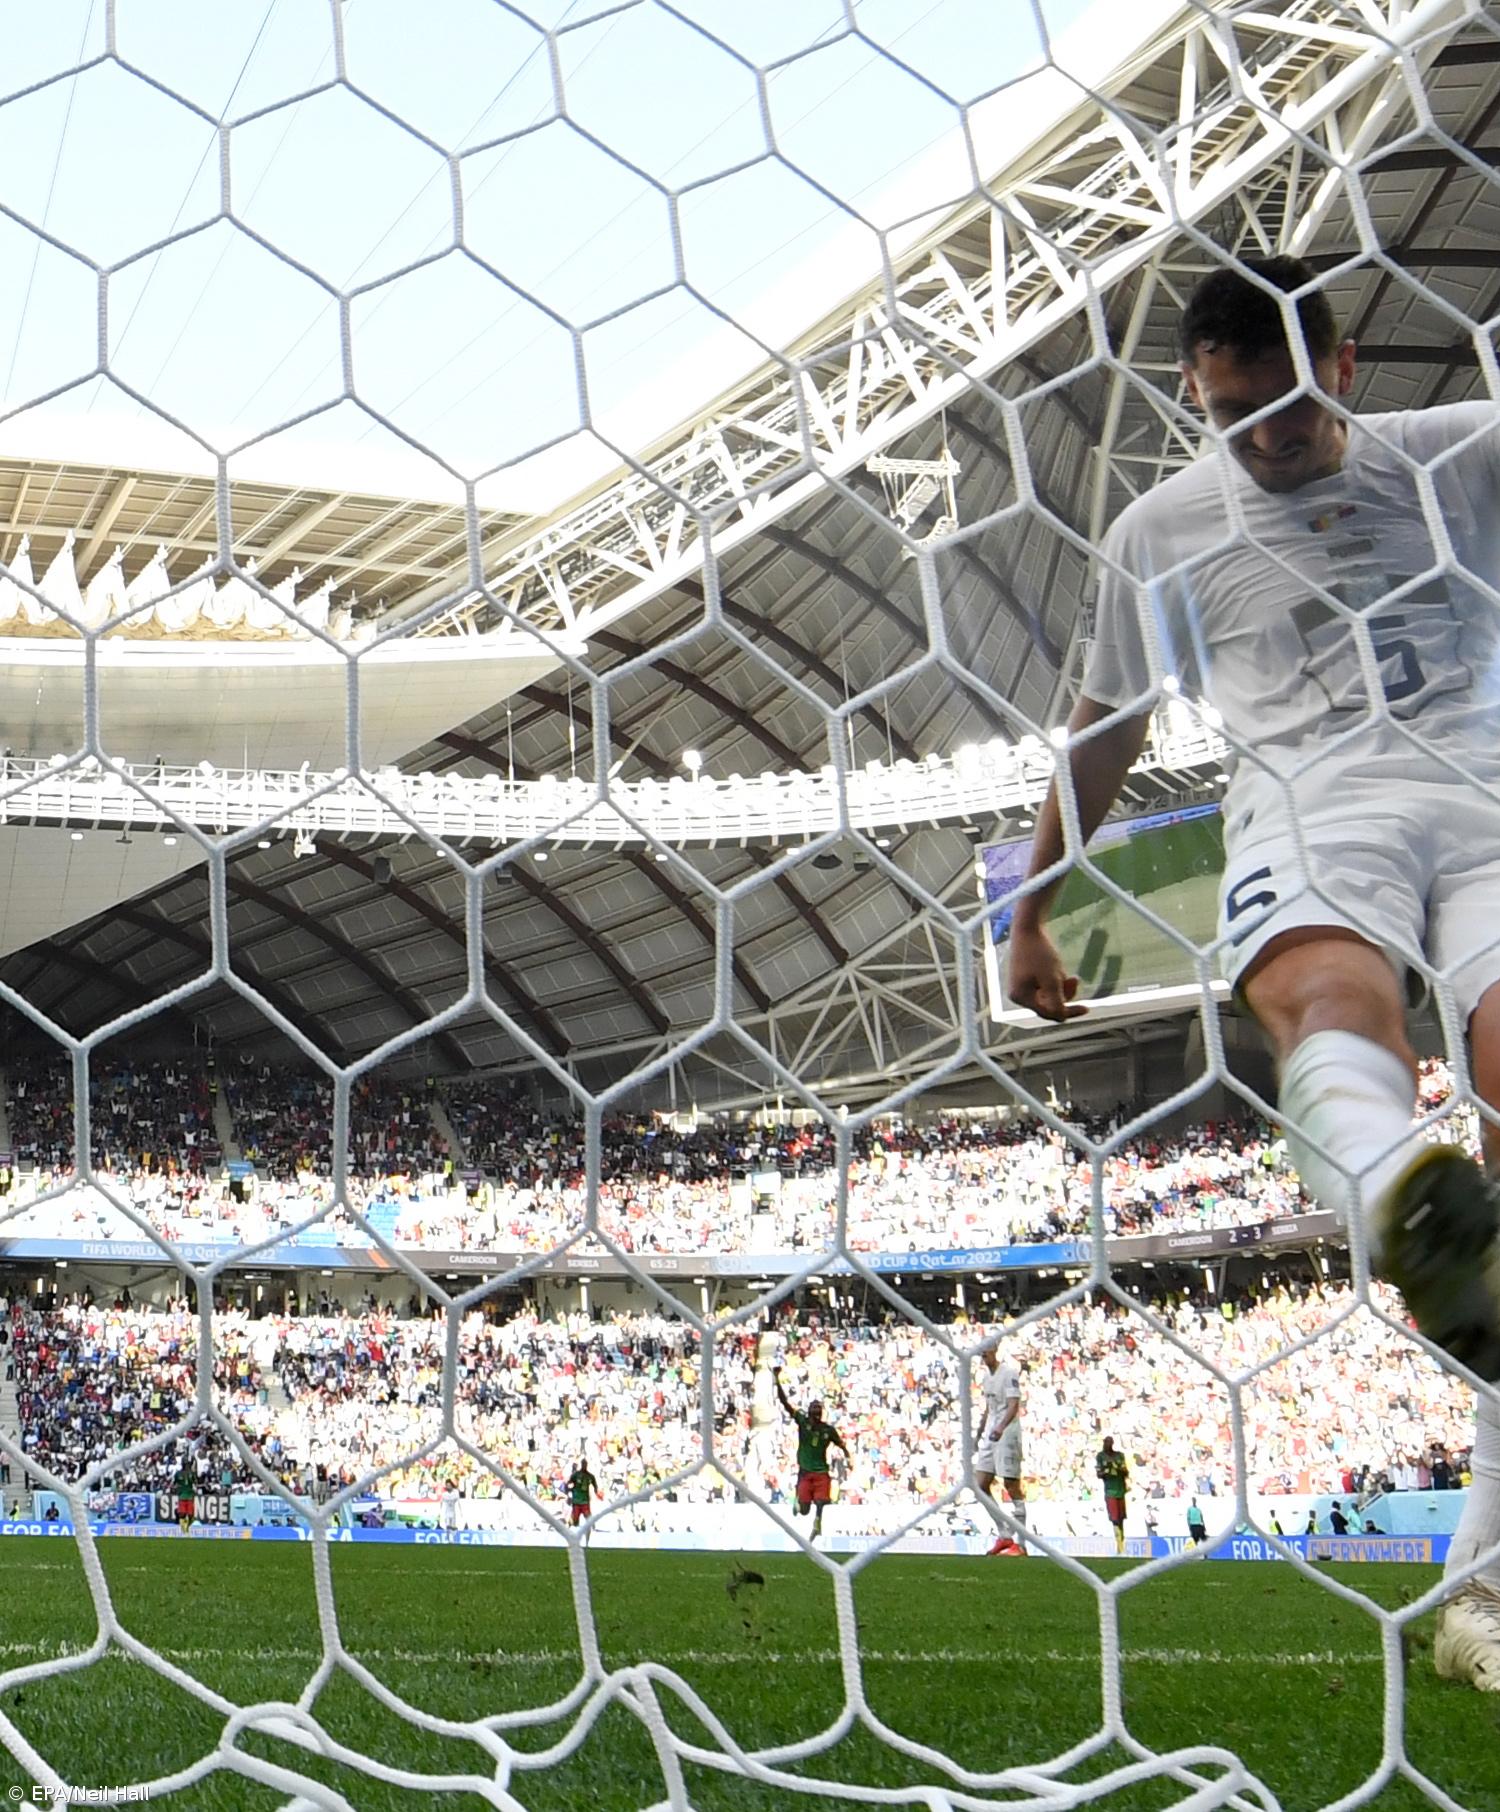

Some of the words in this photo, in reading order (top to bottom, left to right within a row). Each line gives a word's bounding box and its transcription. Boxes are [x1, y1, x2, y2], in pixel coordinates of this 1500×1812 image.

[1360, 614, 1427, 703] 5
[1229, 1231, 1238, 1244] 2
[1253, 1227, 1263, 1240] 3
[82, 1243, 110, 1256] FIFA
[110, 1244, 156, 1257] WORLD
[883, 1256, 908, 1268] CUP
[2, 1524, 42, 1536] FOR
[48, 1525, 98, 1537] FAS
[1232, 1540, 1261, 1560] FOR
